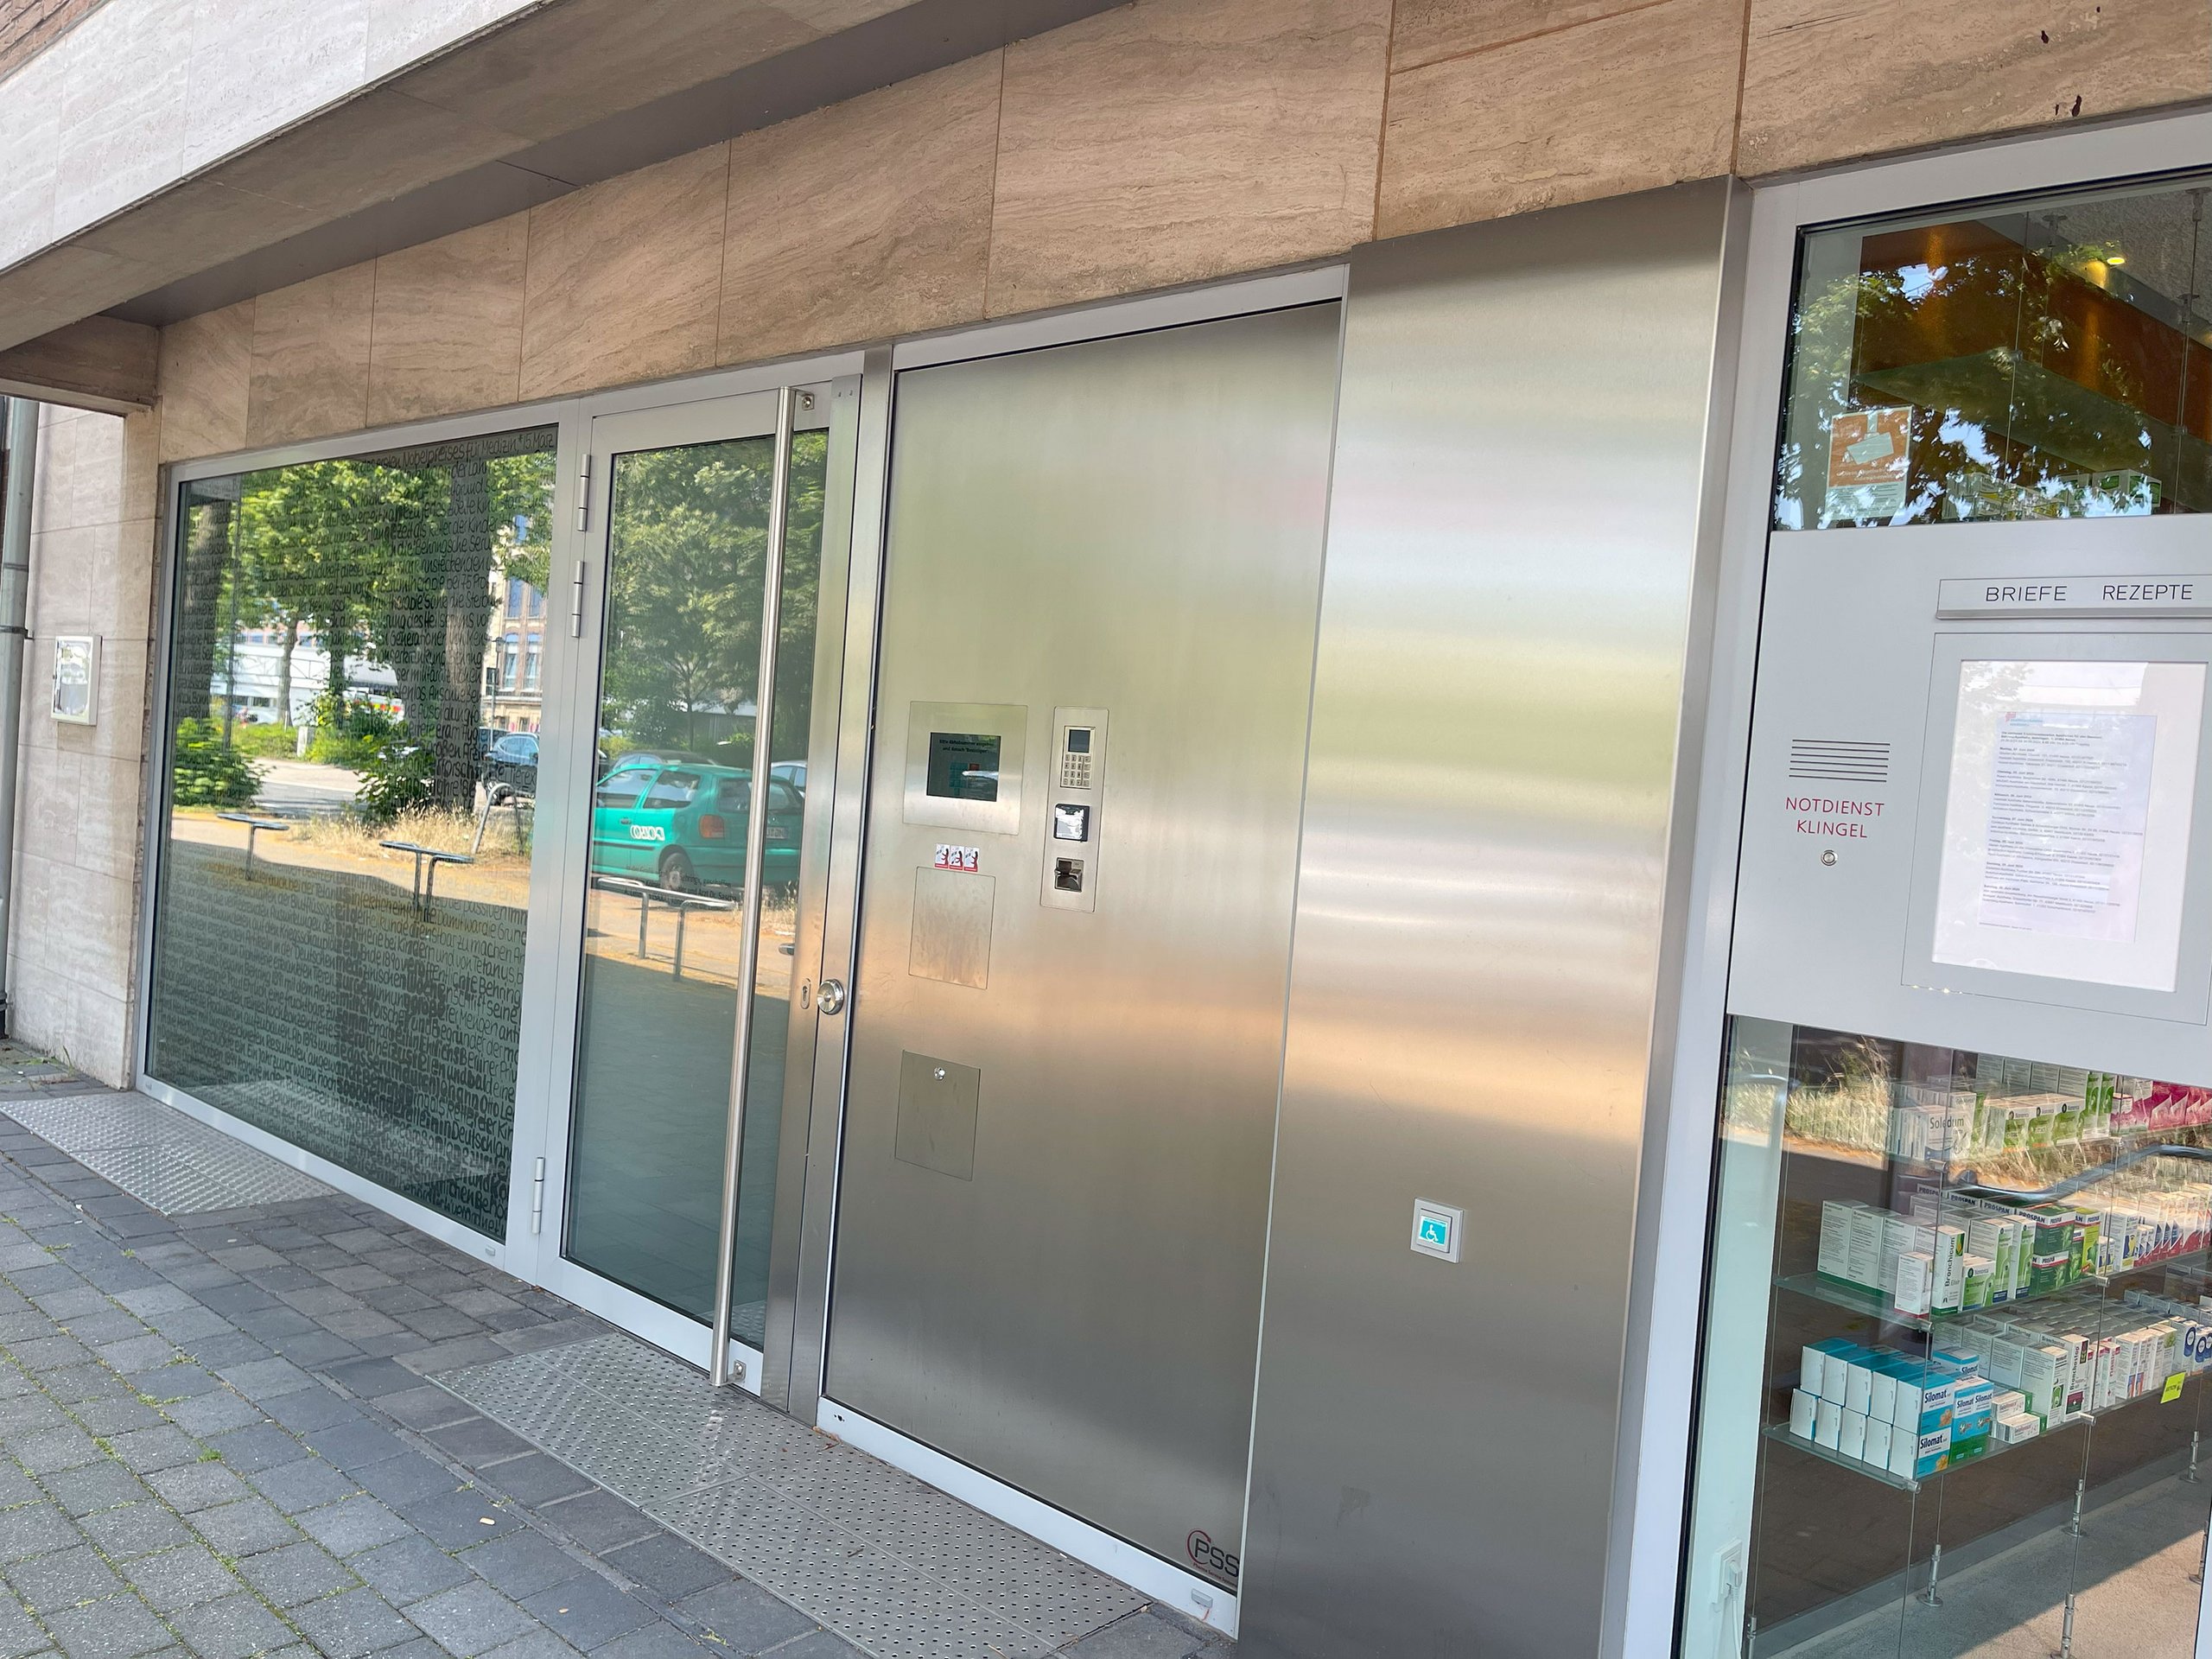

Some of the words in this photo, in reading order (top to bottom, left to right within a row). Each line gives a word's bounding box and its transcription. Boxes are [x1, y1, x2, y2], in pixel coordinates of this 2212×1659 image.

[1986, 586, 2067, 601] BRIEFE
[2103, 584, 2193, 601] REZEPTE
[1785, 797, 1885, 817] NOTDIENST
[1797, 819, 1867, 838] KLINGEL
[1929, 1116, 1964, 1130] Soledum
[1951, 1194, 1976, 1205] PROSPAN
[1984, 1202, 2010, 1214] PROSPAN
[2018, 1211, 2046, 1224] PROSPAN
[1944, 1236, 1955, 1287] Bronchicum
[1924, 1389, 1947, 1404] Silomat
[1957, 1397, 1974, 1408] Silomat
[1975, 1393, 1993, 1403] Silomat
[1920, 1434, 1943, 1449] Silomat
[1194, 1537, 1240, 1578] PSS
